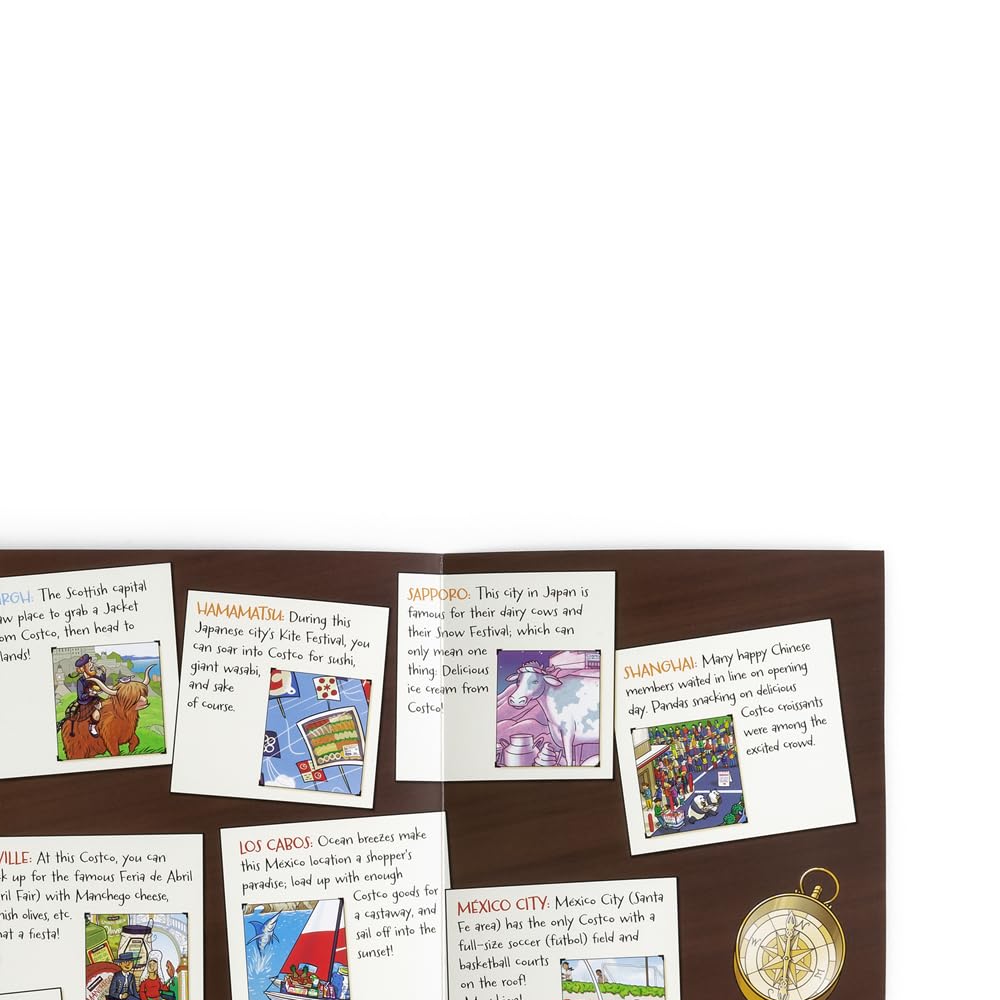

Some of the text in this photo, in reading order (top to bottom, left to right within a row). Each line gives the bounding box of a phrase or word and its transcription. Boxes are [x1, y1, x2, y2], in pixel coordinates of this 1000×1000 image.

[37, 587, 62, 603] The
[65, 582, 109, 600] Scottish
[112, 579, 148, 599] capital
[407, 585, 589, 604] SAPPORO: This city in Japan is
[196, 601, 352, 631] HAMAMATSU: During this
[623, 641, 811, 680] SHANGHAI: Many happy Chinese
[407, 701, 444, 714] Costco!
[239, 826, 427, 856] LOS CABOS: Ocean breezes make
[36, 850, 51, 866] At
[55, 849, 75, 864] this
[79, 850, 118, 865] Costco,
[121, 853, 143, 868] you
[146, 853, 167, 864] can
[457, 890, 664, 917] MÉXICO CITY: México City (Santa
[17, 930, 25, 940] a
[28, 927, 60, 941] fiesta!
[357, 944, 394, 960] sunset!
